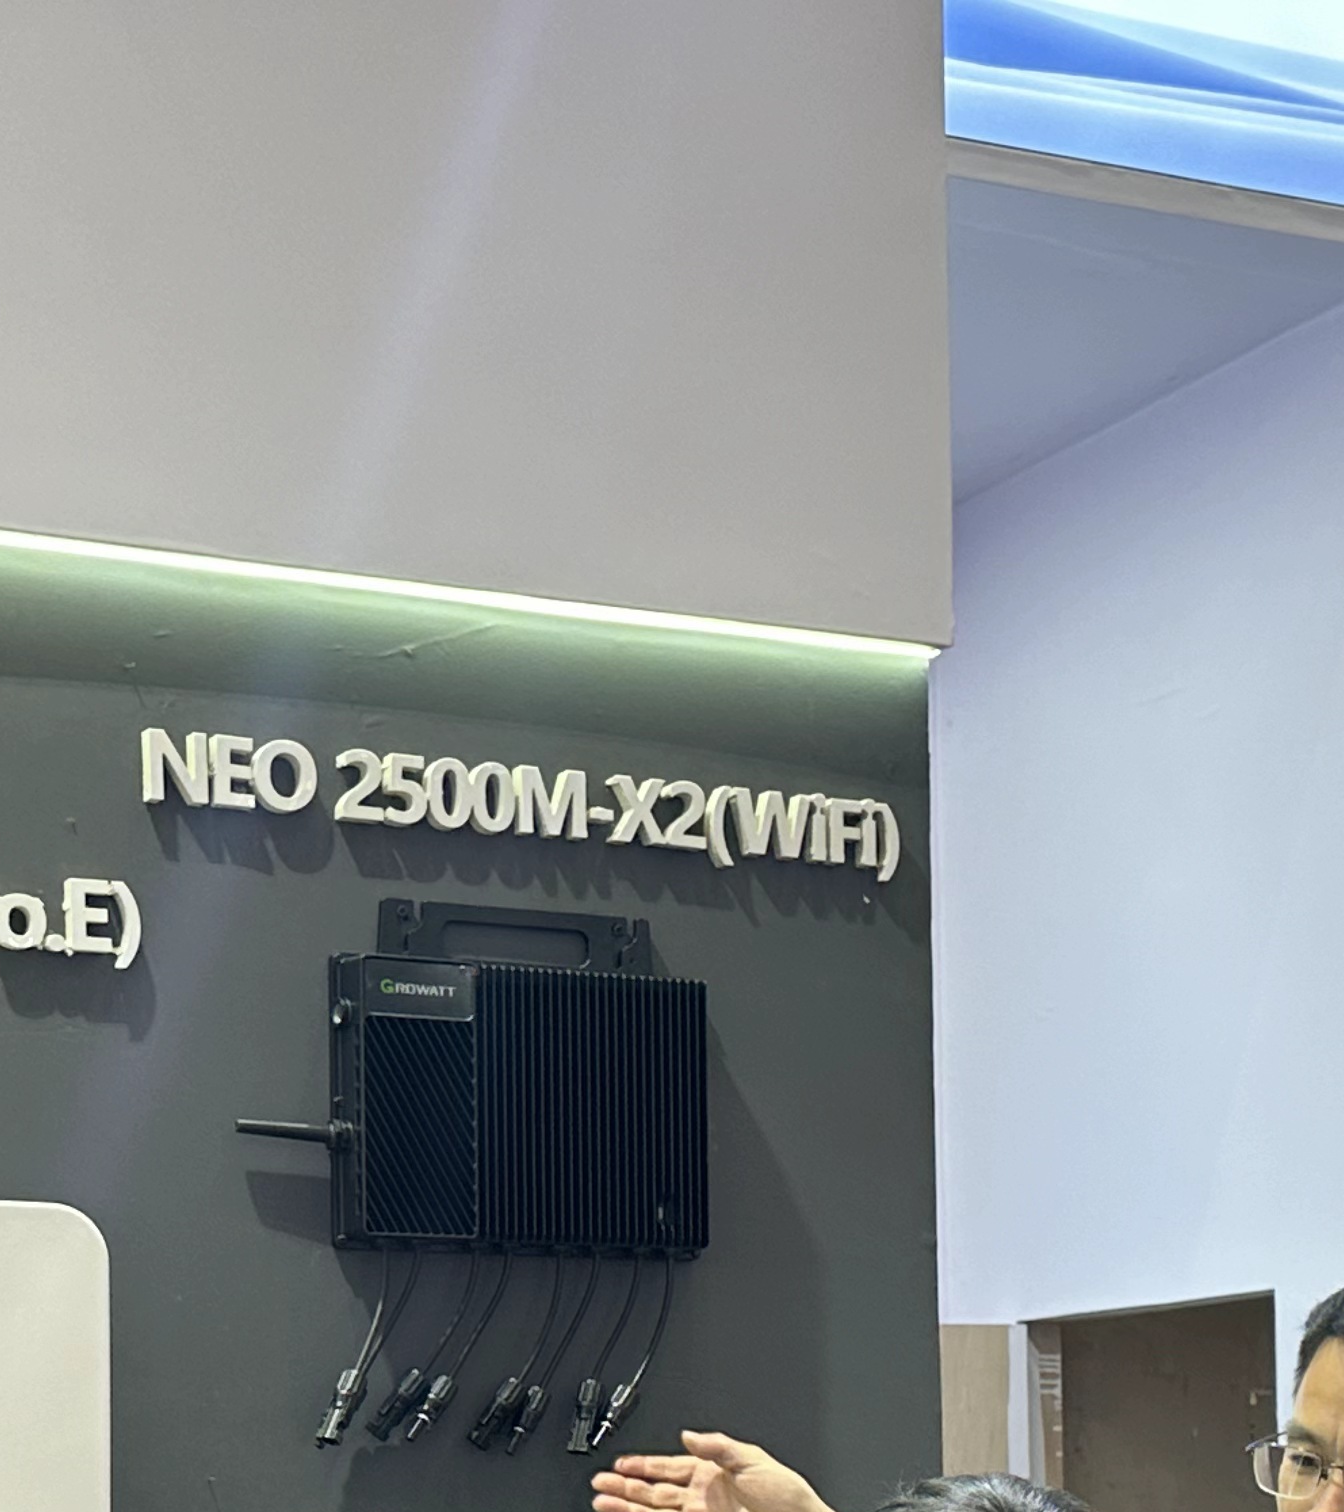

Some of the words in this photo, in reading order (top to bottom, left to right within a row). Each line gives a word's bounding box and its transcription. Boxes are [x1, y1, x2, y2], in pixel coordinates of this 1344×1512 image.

[140, 726, 318, 815] NEO
[333, 747, 901, 882] 2500M-X2(WiFi)
[380, 978, 457, 998] GROWATT
